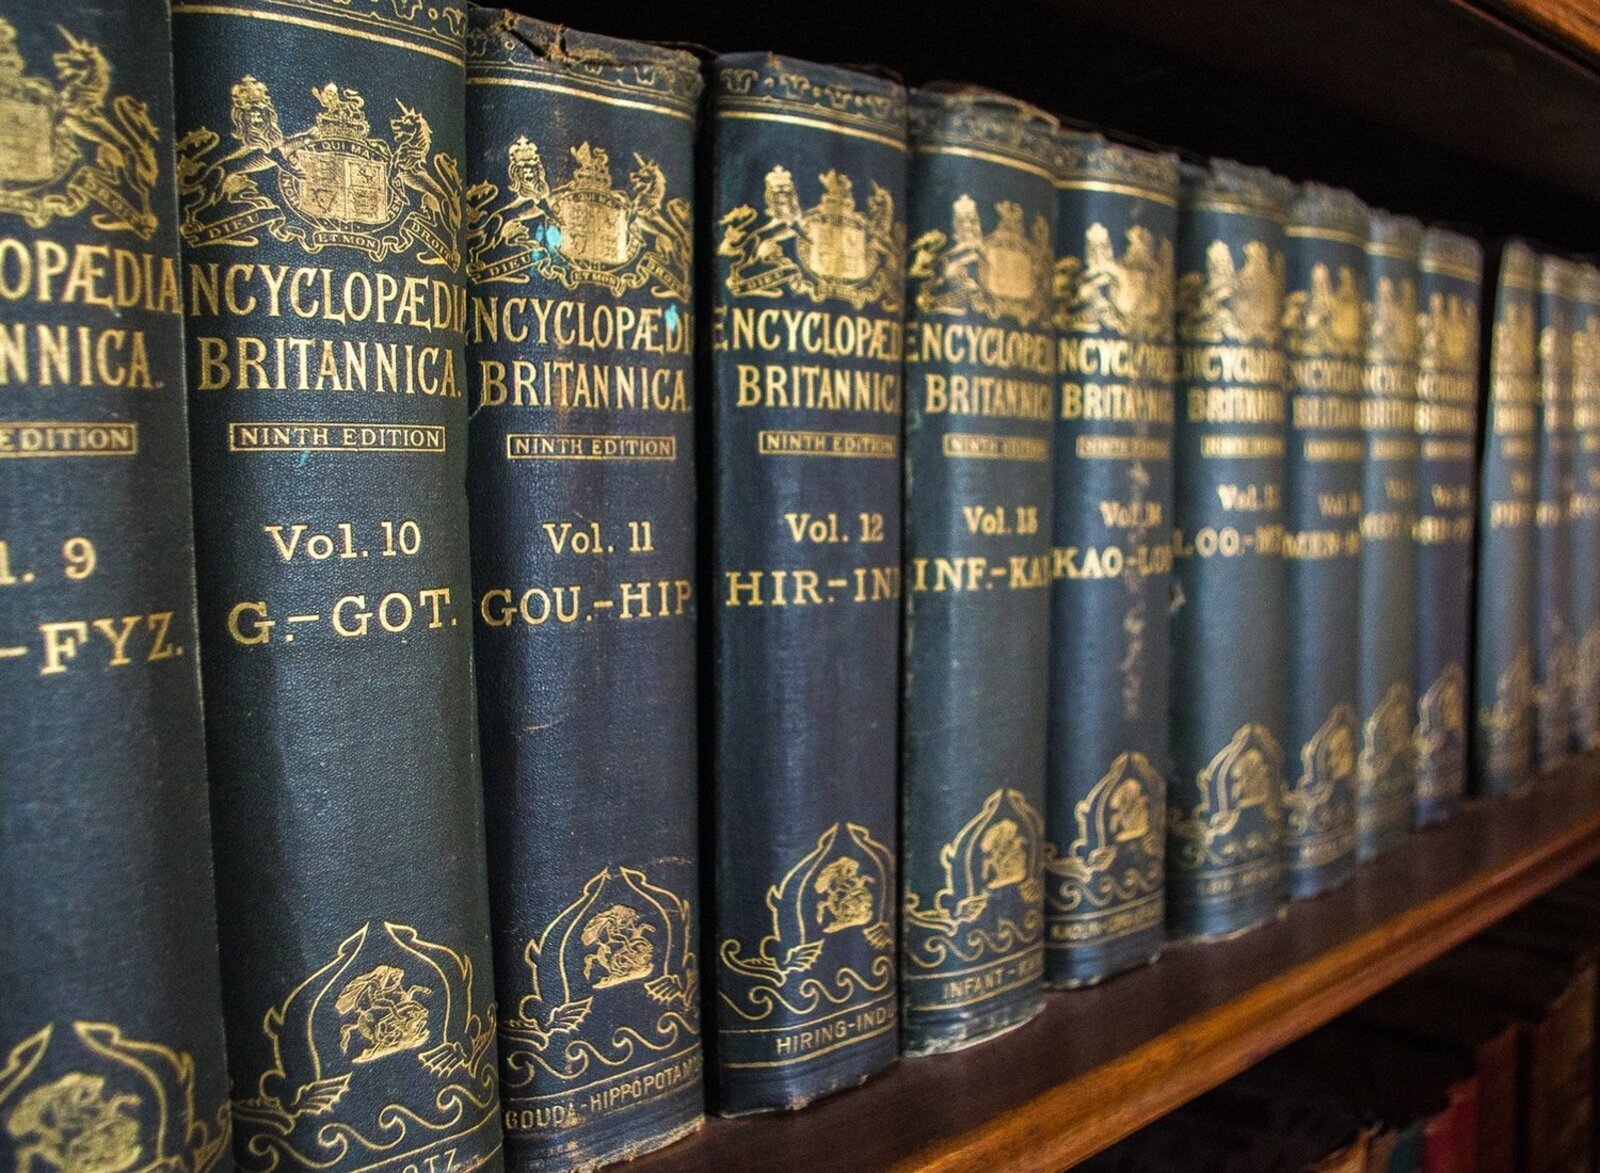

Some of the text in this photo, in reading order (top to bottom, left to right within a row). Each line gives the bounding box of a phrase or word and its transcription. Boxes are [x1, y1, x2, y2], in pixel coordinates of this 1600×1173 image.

[208, 213, 262, 239] DIEU
[318, 233, 338, 244] ET
[341, 235, 374, 250] MON
[196, 336, 462, 398] BRITANNICA.
[241, 427, 440, 447] NINTH EDITION
[515, 438, 672, 456] NINTH EDITION
[766, 433, 826, 451] NINTH
[264, 520, 422, 561] Vol. 10
[543, 520, 655, 554] Vol. 11
[785, 512, 884, 543] Vol. 12
[63, 536, 97, 580] 9
